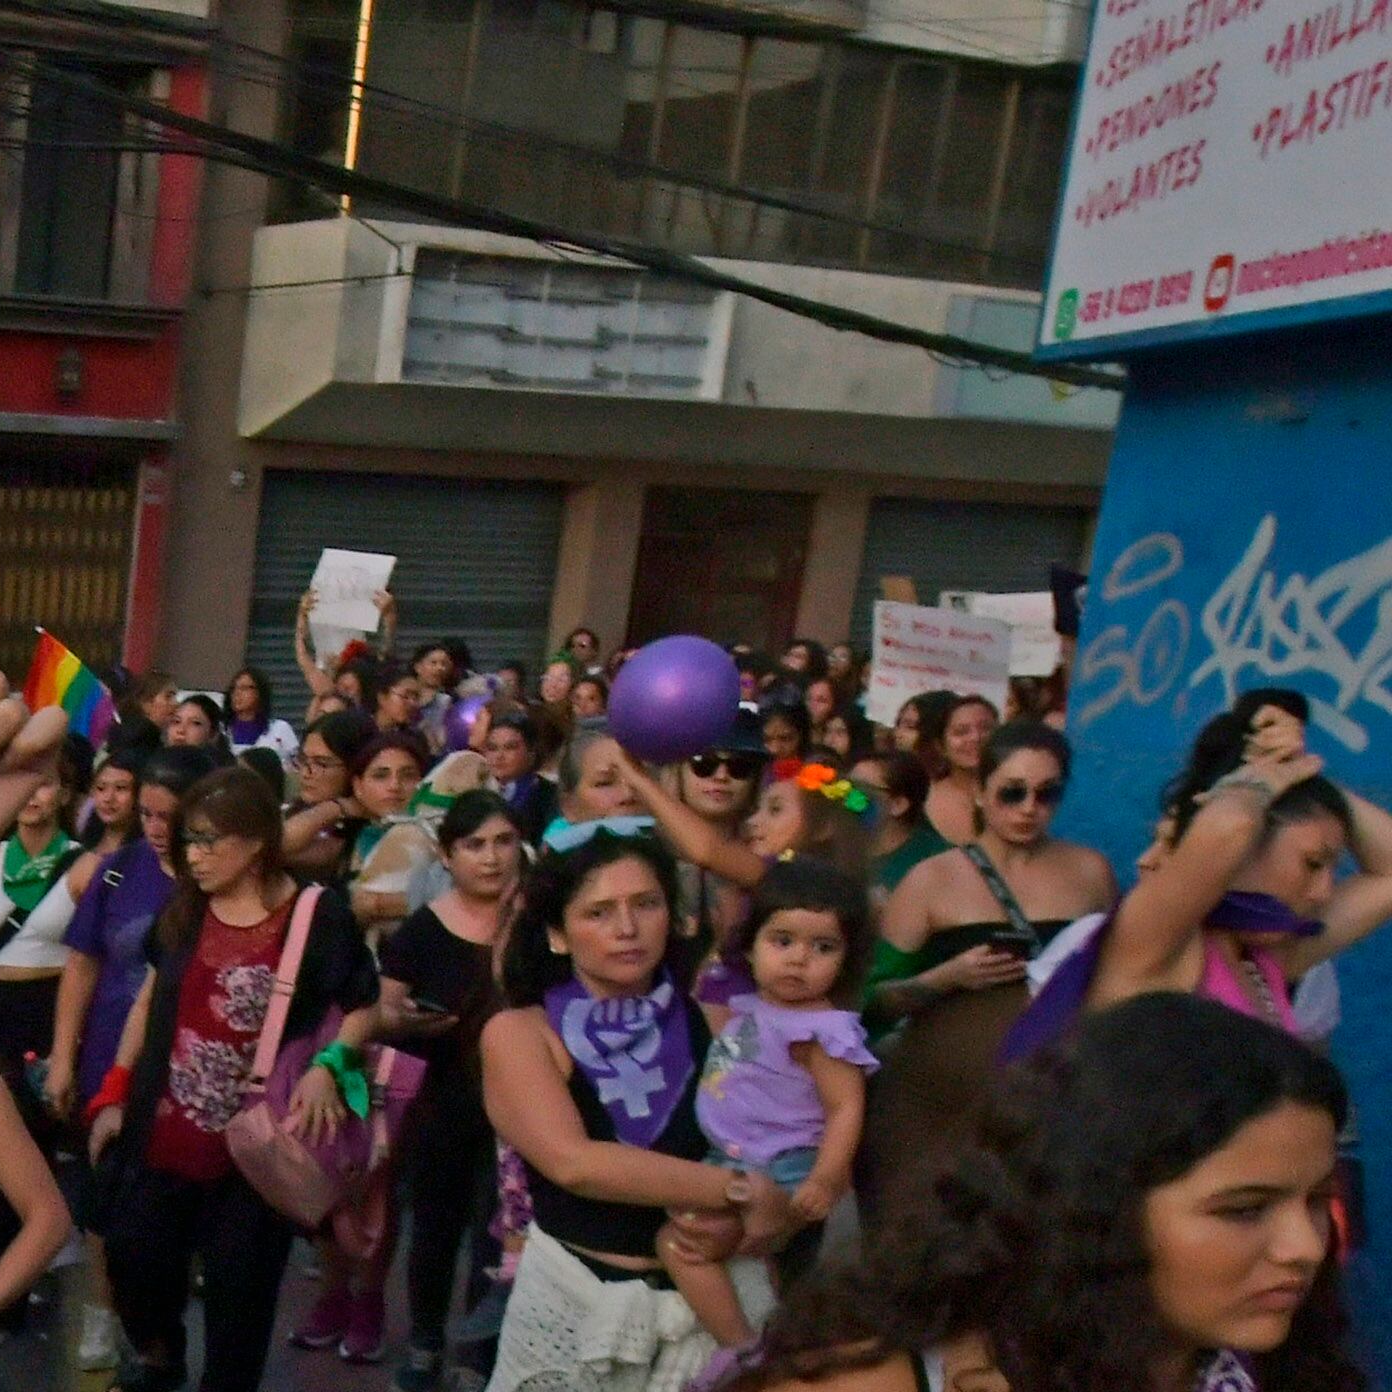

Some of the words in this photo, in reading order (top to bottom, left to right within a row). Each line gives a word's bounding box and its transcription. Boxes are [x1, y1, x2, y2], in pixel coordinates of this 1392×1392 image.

[1102, 0, 1263, 88] SEÑALETIC
[1094, 61, 1221, 161] PENDONES
[1082, 139, 1206, 228] VOLANTES
